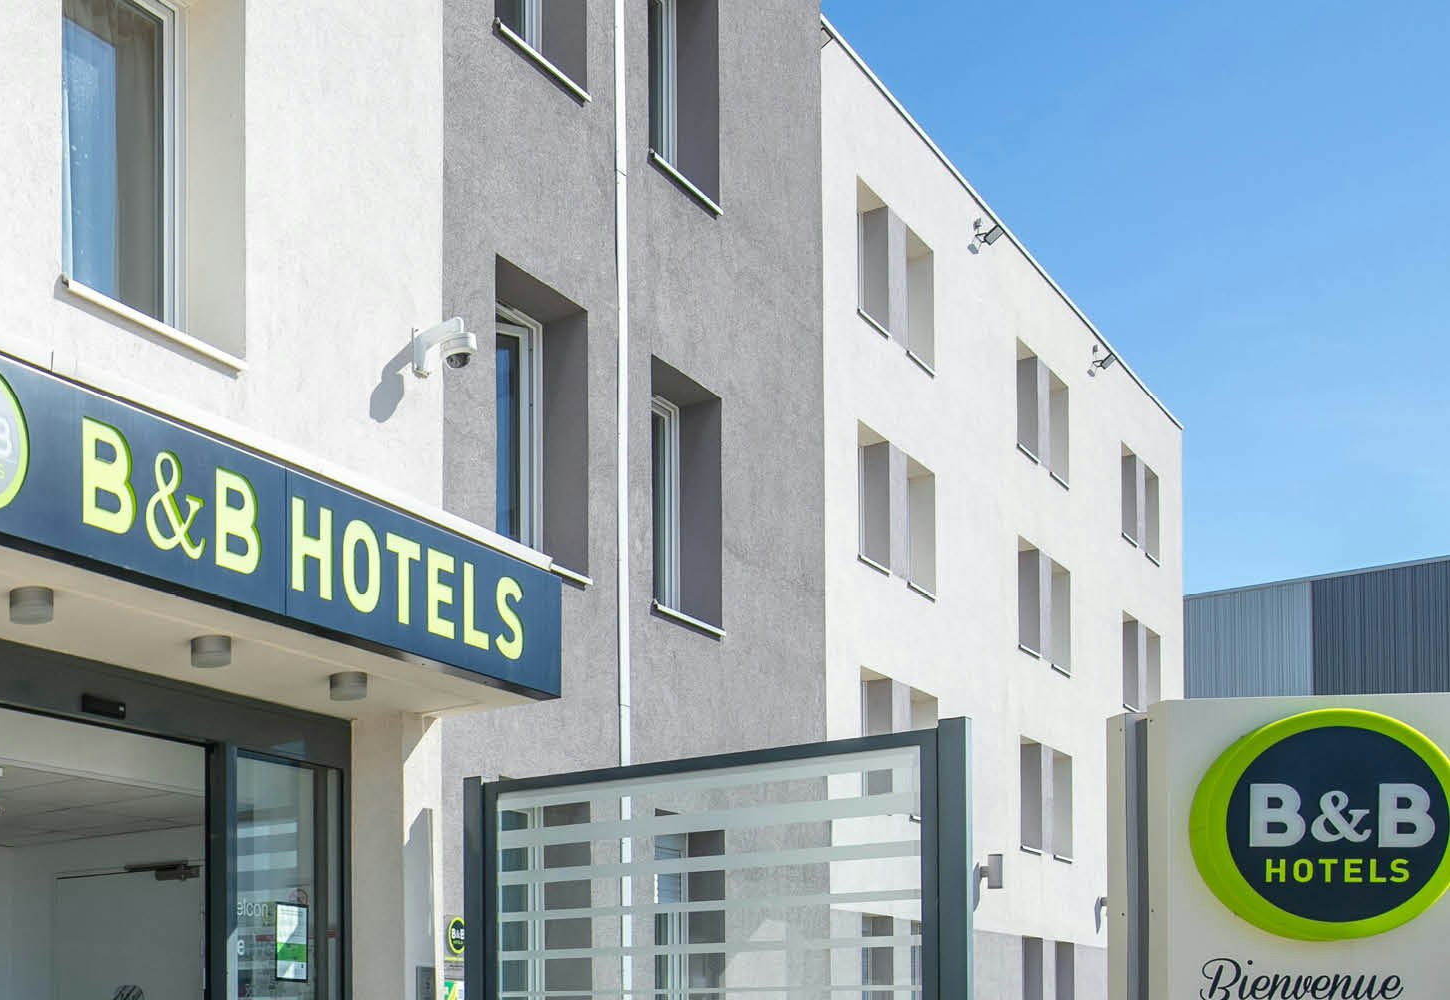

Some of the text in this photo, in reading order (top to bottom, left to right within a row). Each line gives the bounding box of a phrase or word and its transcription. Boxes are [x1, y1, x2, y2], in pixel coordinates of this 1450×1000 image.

[82, 415, 525, 660] B&B HOTELS
[1249, 783, 1436, 848] B&B
[1265, 858, 1411, 883] HOTELS
